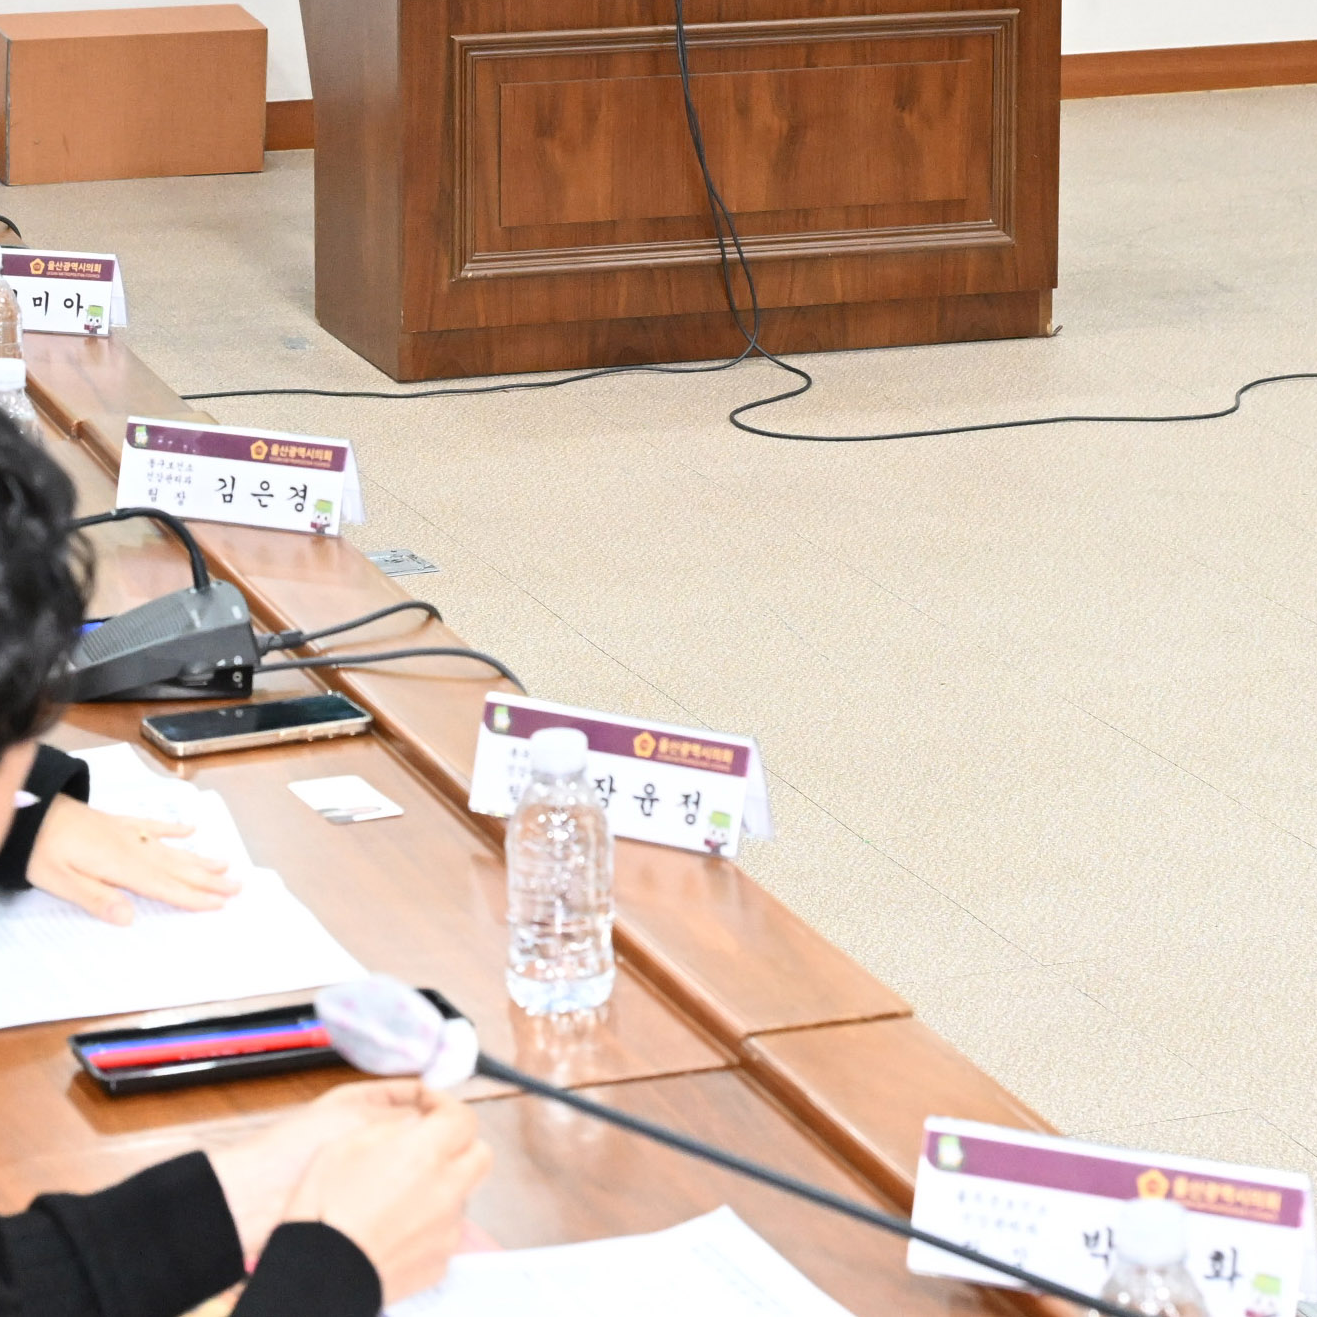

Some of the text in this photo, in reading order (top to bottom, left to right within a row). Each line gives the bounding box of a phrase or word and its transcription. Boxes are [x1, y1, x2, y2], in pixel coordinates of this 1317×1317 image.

[47, 260, 102, 274] 울산광역시의회
[214, 475, 308, 513] 김은경
[1083, 1226, 1241, 1287] 박화
